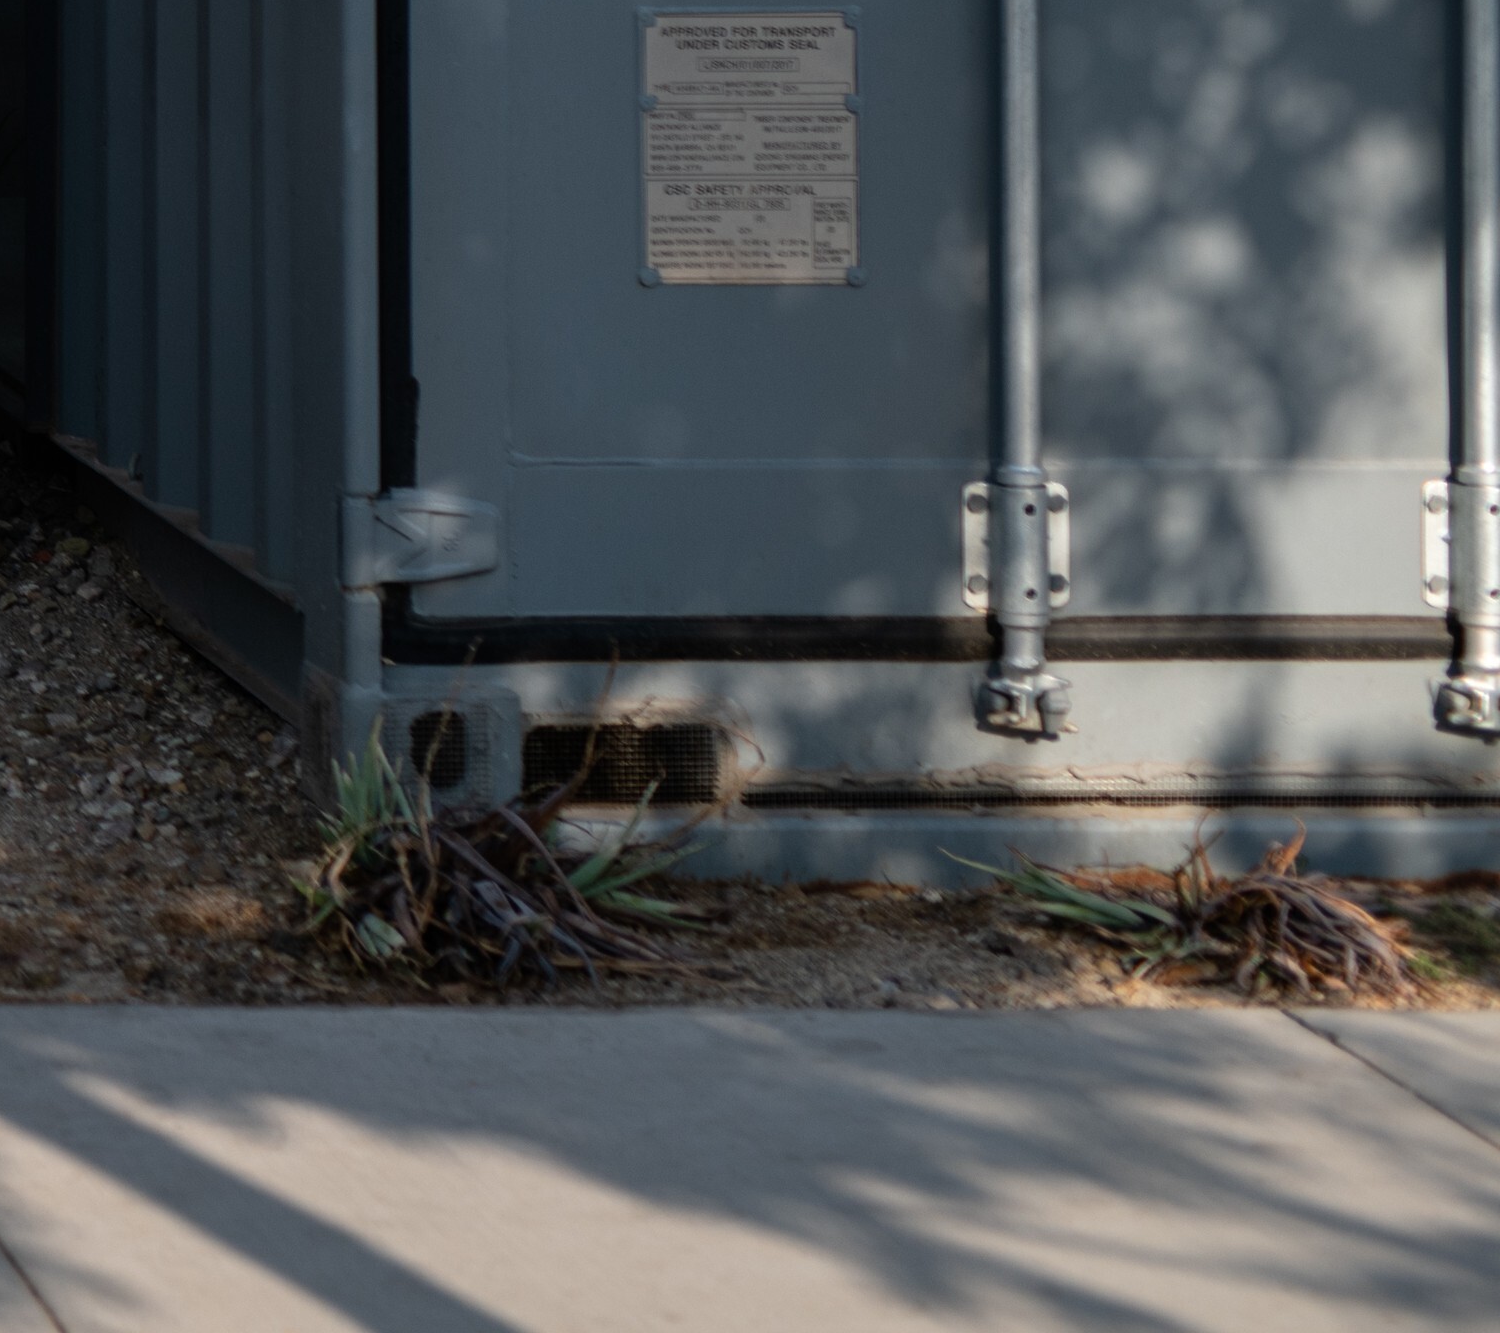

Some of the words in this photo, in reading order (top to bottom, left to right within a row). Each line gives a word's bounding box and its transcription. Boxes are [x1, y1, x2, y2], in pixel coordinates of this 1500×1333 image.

[661, 26, 729, 38] APPROVED
[730, 26, 759, 38] FOR
[760, 26, 837, 38] TRANSPORT
[675, 39, 721, 50] UNDER
[724, 39, 786, 51] CUSTOMS
[788, 39, 822, 51] SEAL
[663, 185, 692, 196] CSC
[694, 184, 745, 196] SAFETY
[750, 184, 817, 196] APPROVAL
